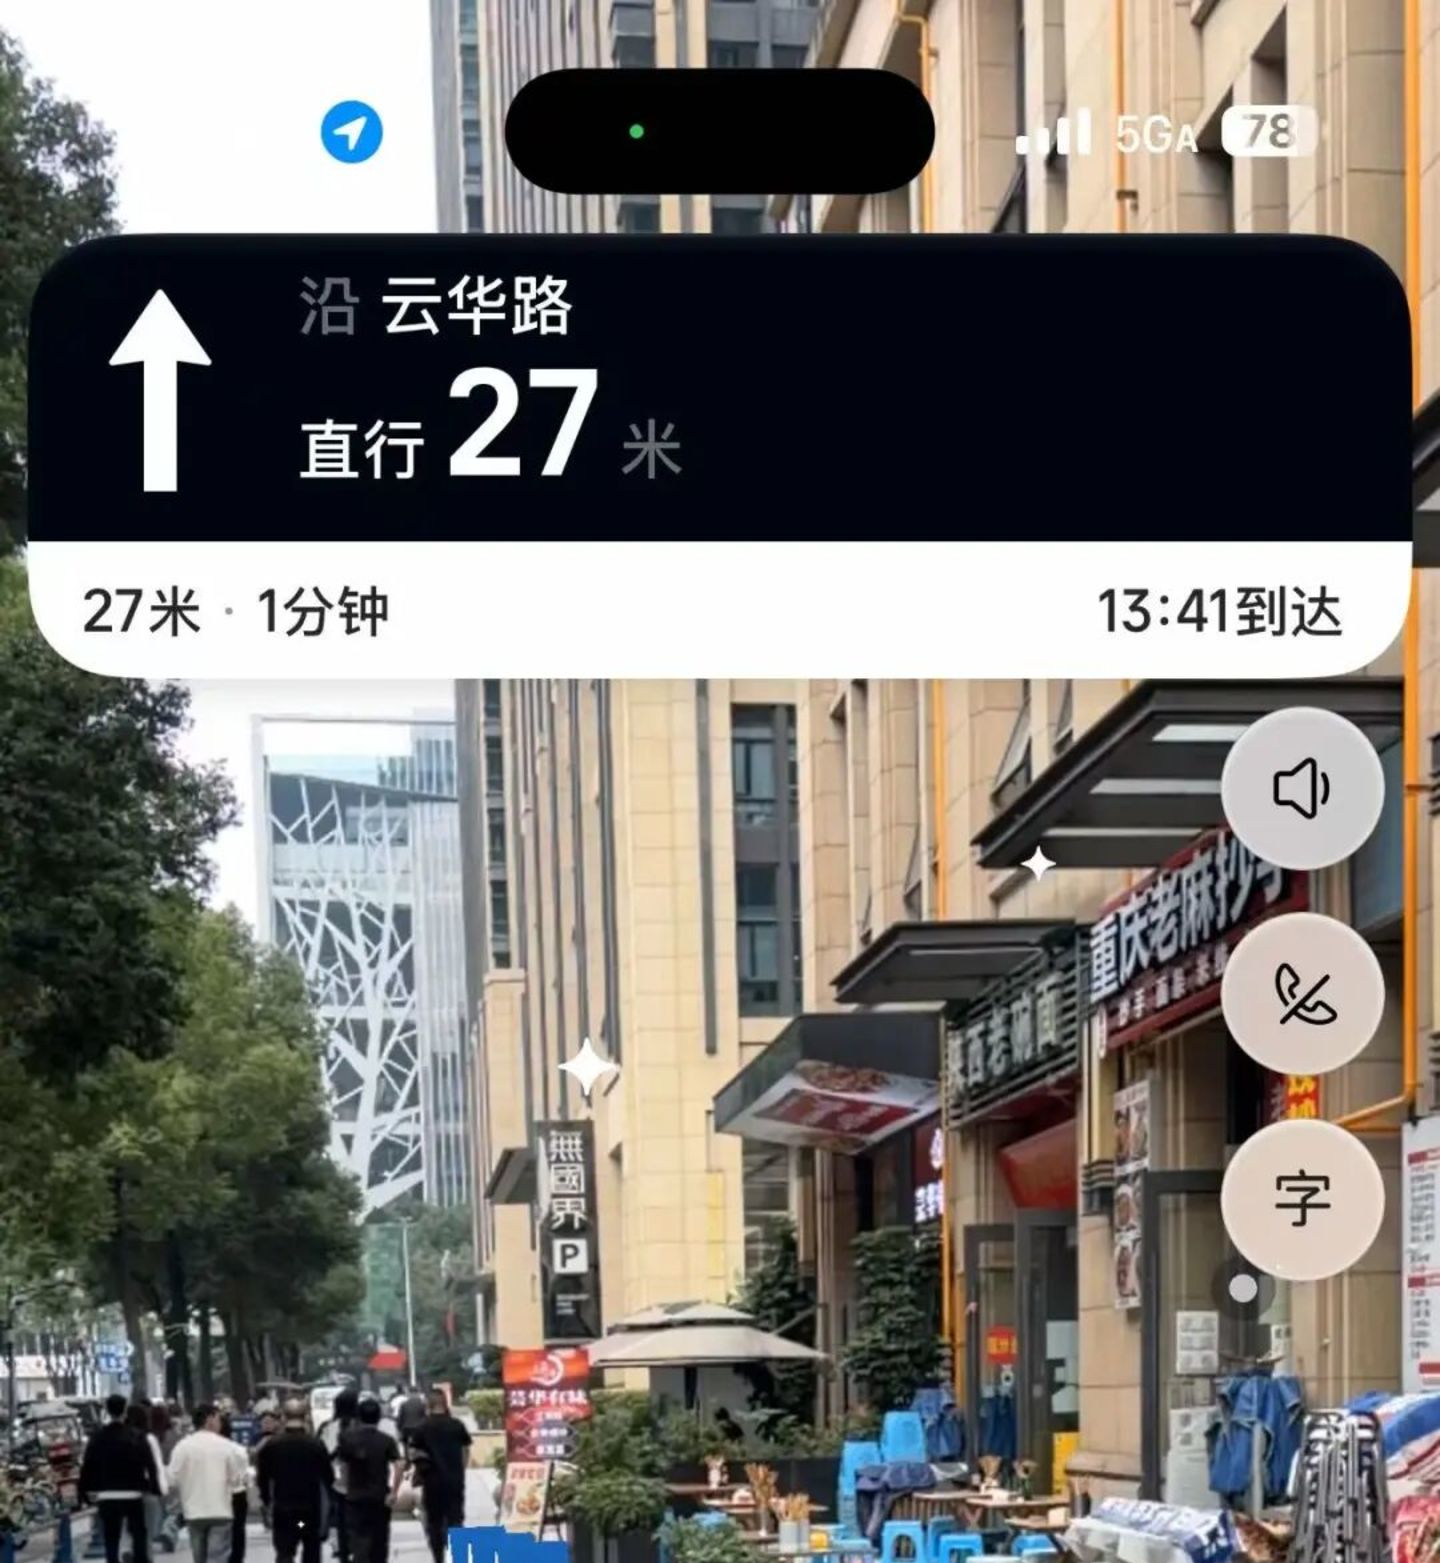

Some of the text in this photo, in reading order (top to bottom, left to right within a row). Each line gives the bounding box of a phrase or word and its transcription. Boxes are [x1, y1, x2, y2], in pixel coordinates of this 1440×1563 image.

[550, 1131, 587, 1231] 無國界
[561, 1243, 579, 1269] P
